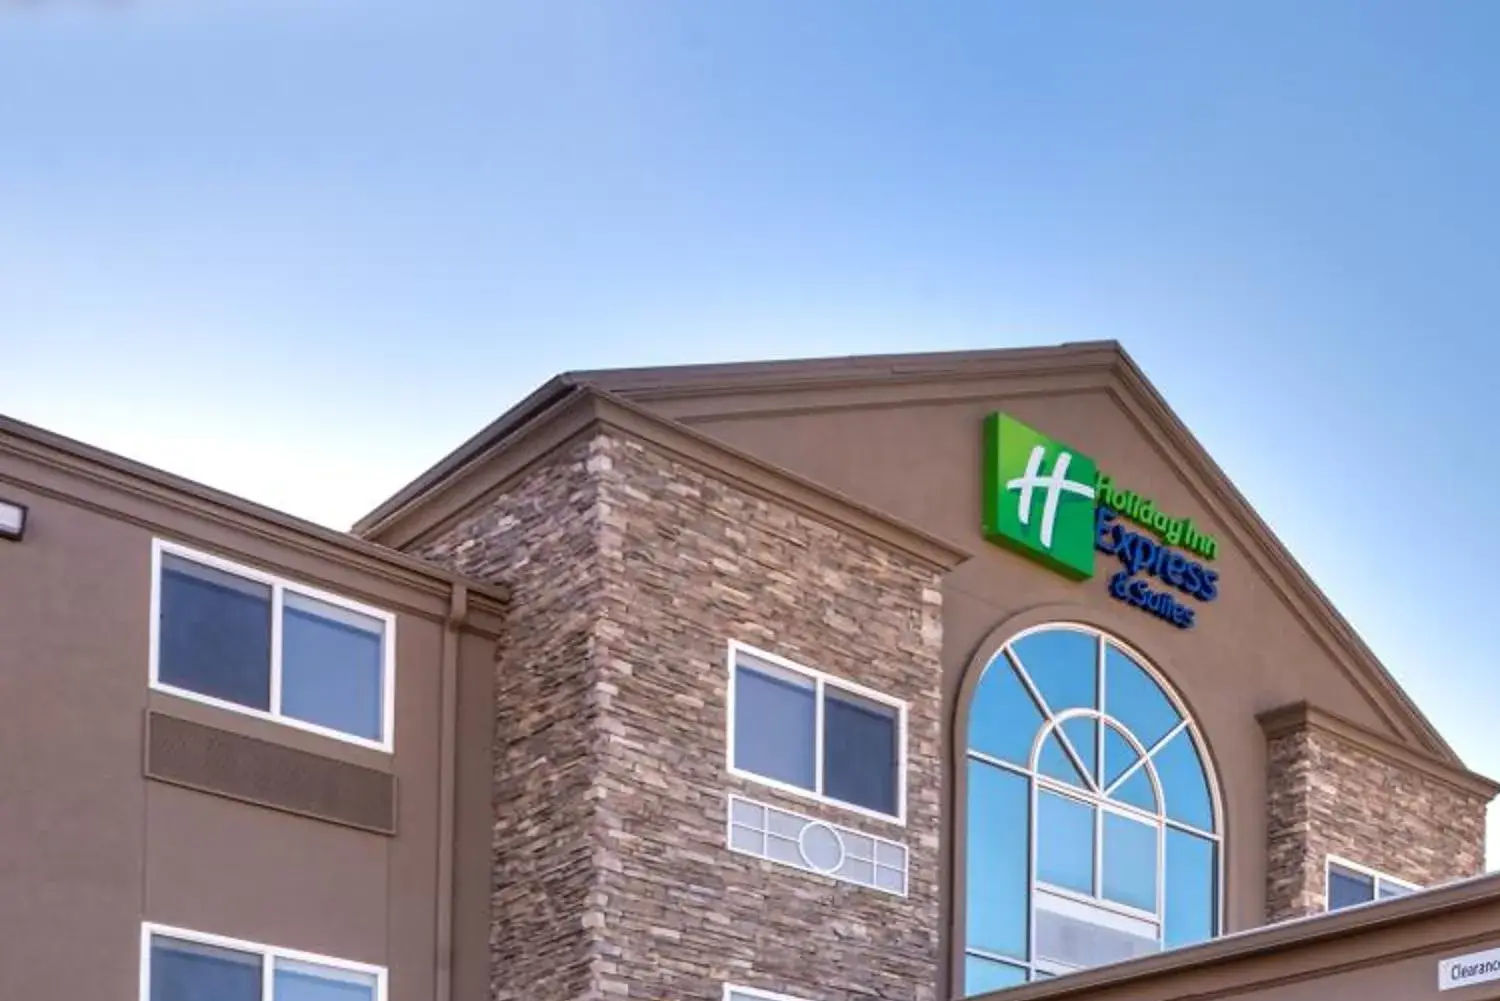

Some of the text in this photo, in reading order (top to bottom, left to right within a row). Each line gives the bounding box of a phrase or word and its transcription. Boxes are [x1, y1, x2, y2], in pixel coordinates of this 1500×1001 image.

[1096, 472, 1219, 560] Holiday Inn
[1096, 505, 1219, 600] Express
[1109, 571, 1195, 628] & Suites
